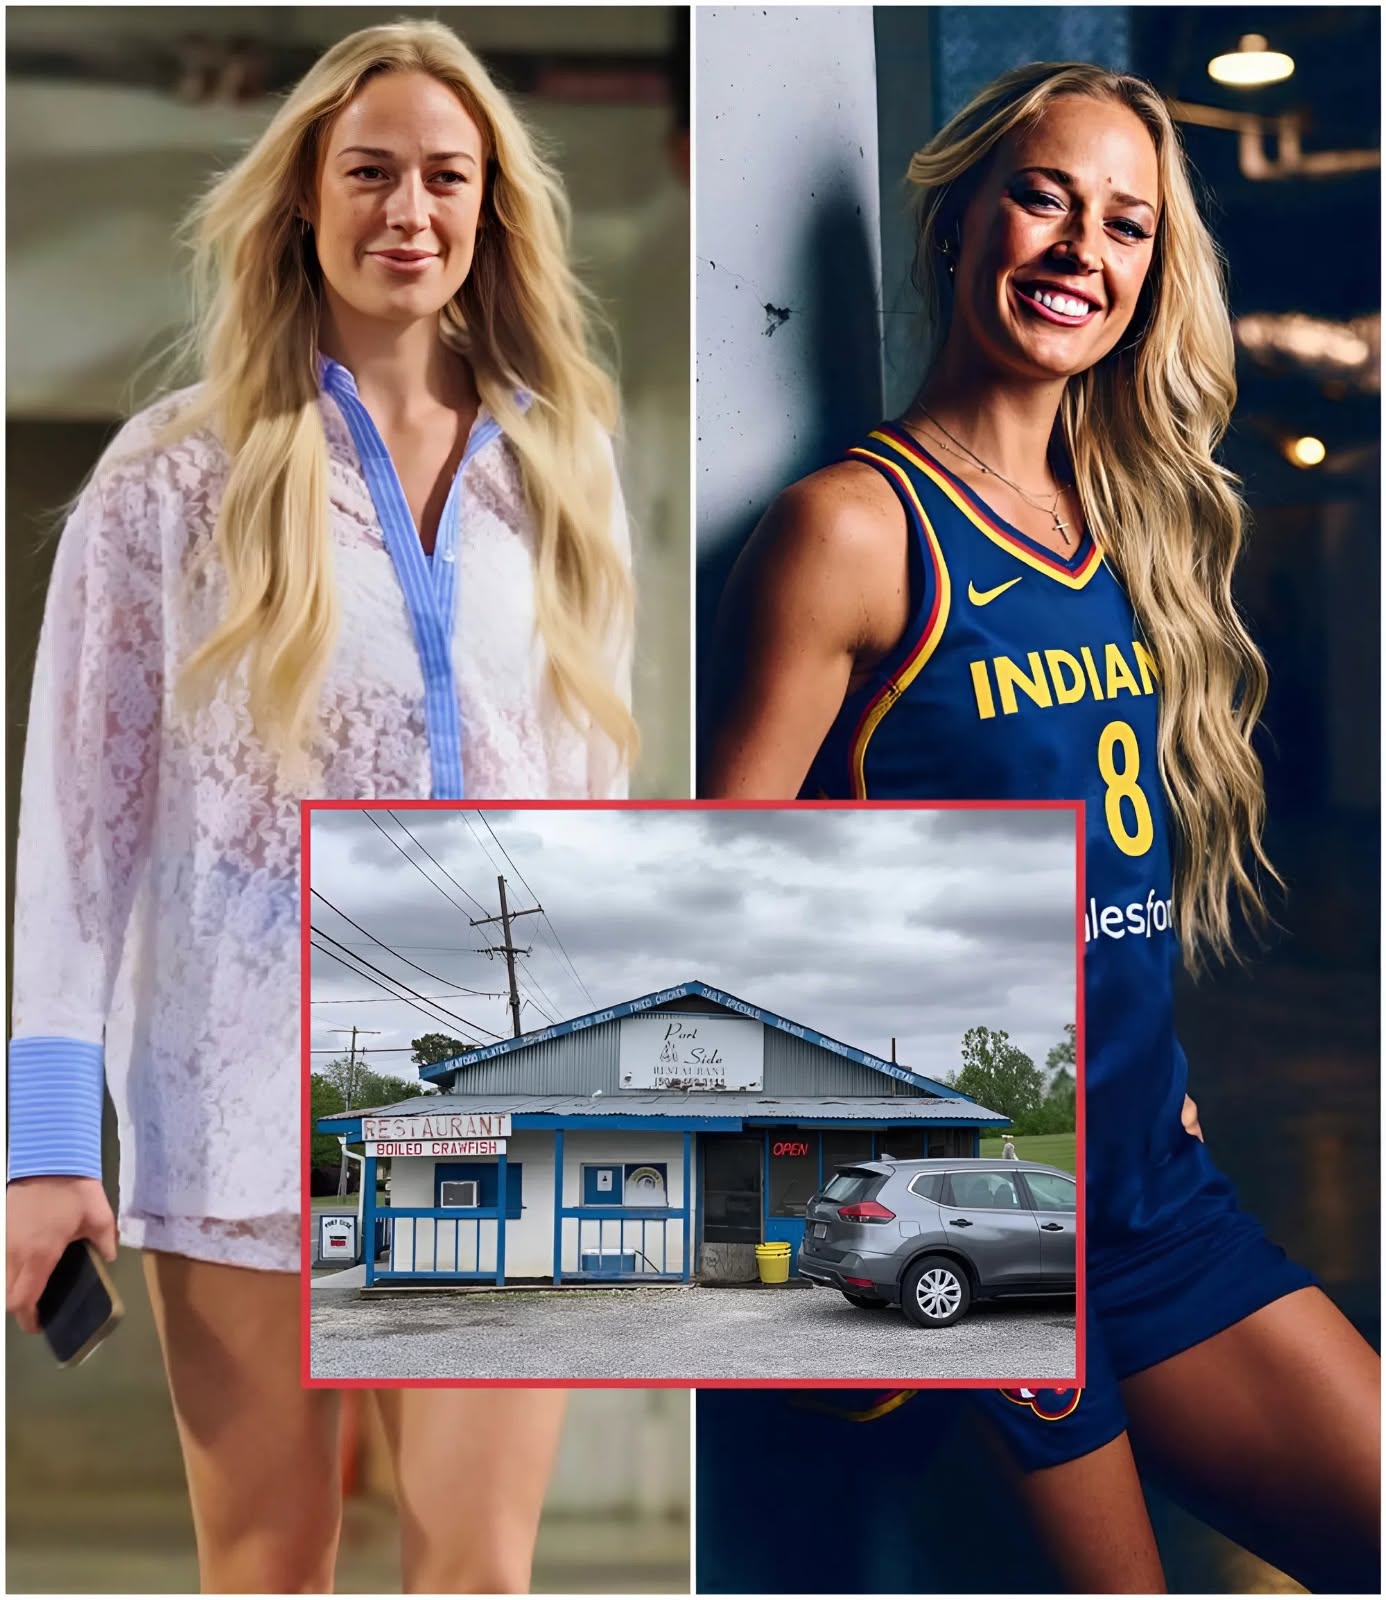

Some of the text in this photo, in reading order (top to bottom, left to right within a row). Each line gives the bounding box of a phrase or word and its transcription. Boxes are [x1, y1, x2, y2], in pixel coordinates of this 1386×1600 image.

[1098, 720, 1154, 857] 8
[683, 1047, 723, 1065] Side
[363, 1114, 506, 1140] RESTAURANT
[376, 1141, 498, 1156] BOILED CRAWFISH
[773, 1142, 808, 1157] OPEN
